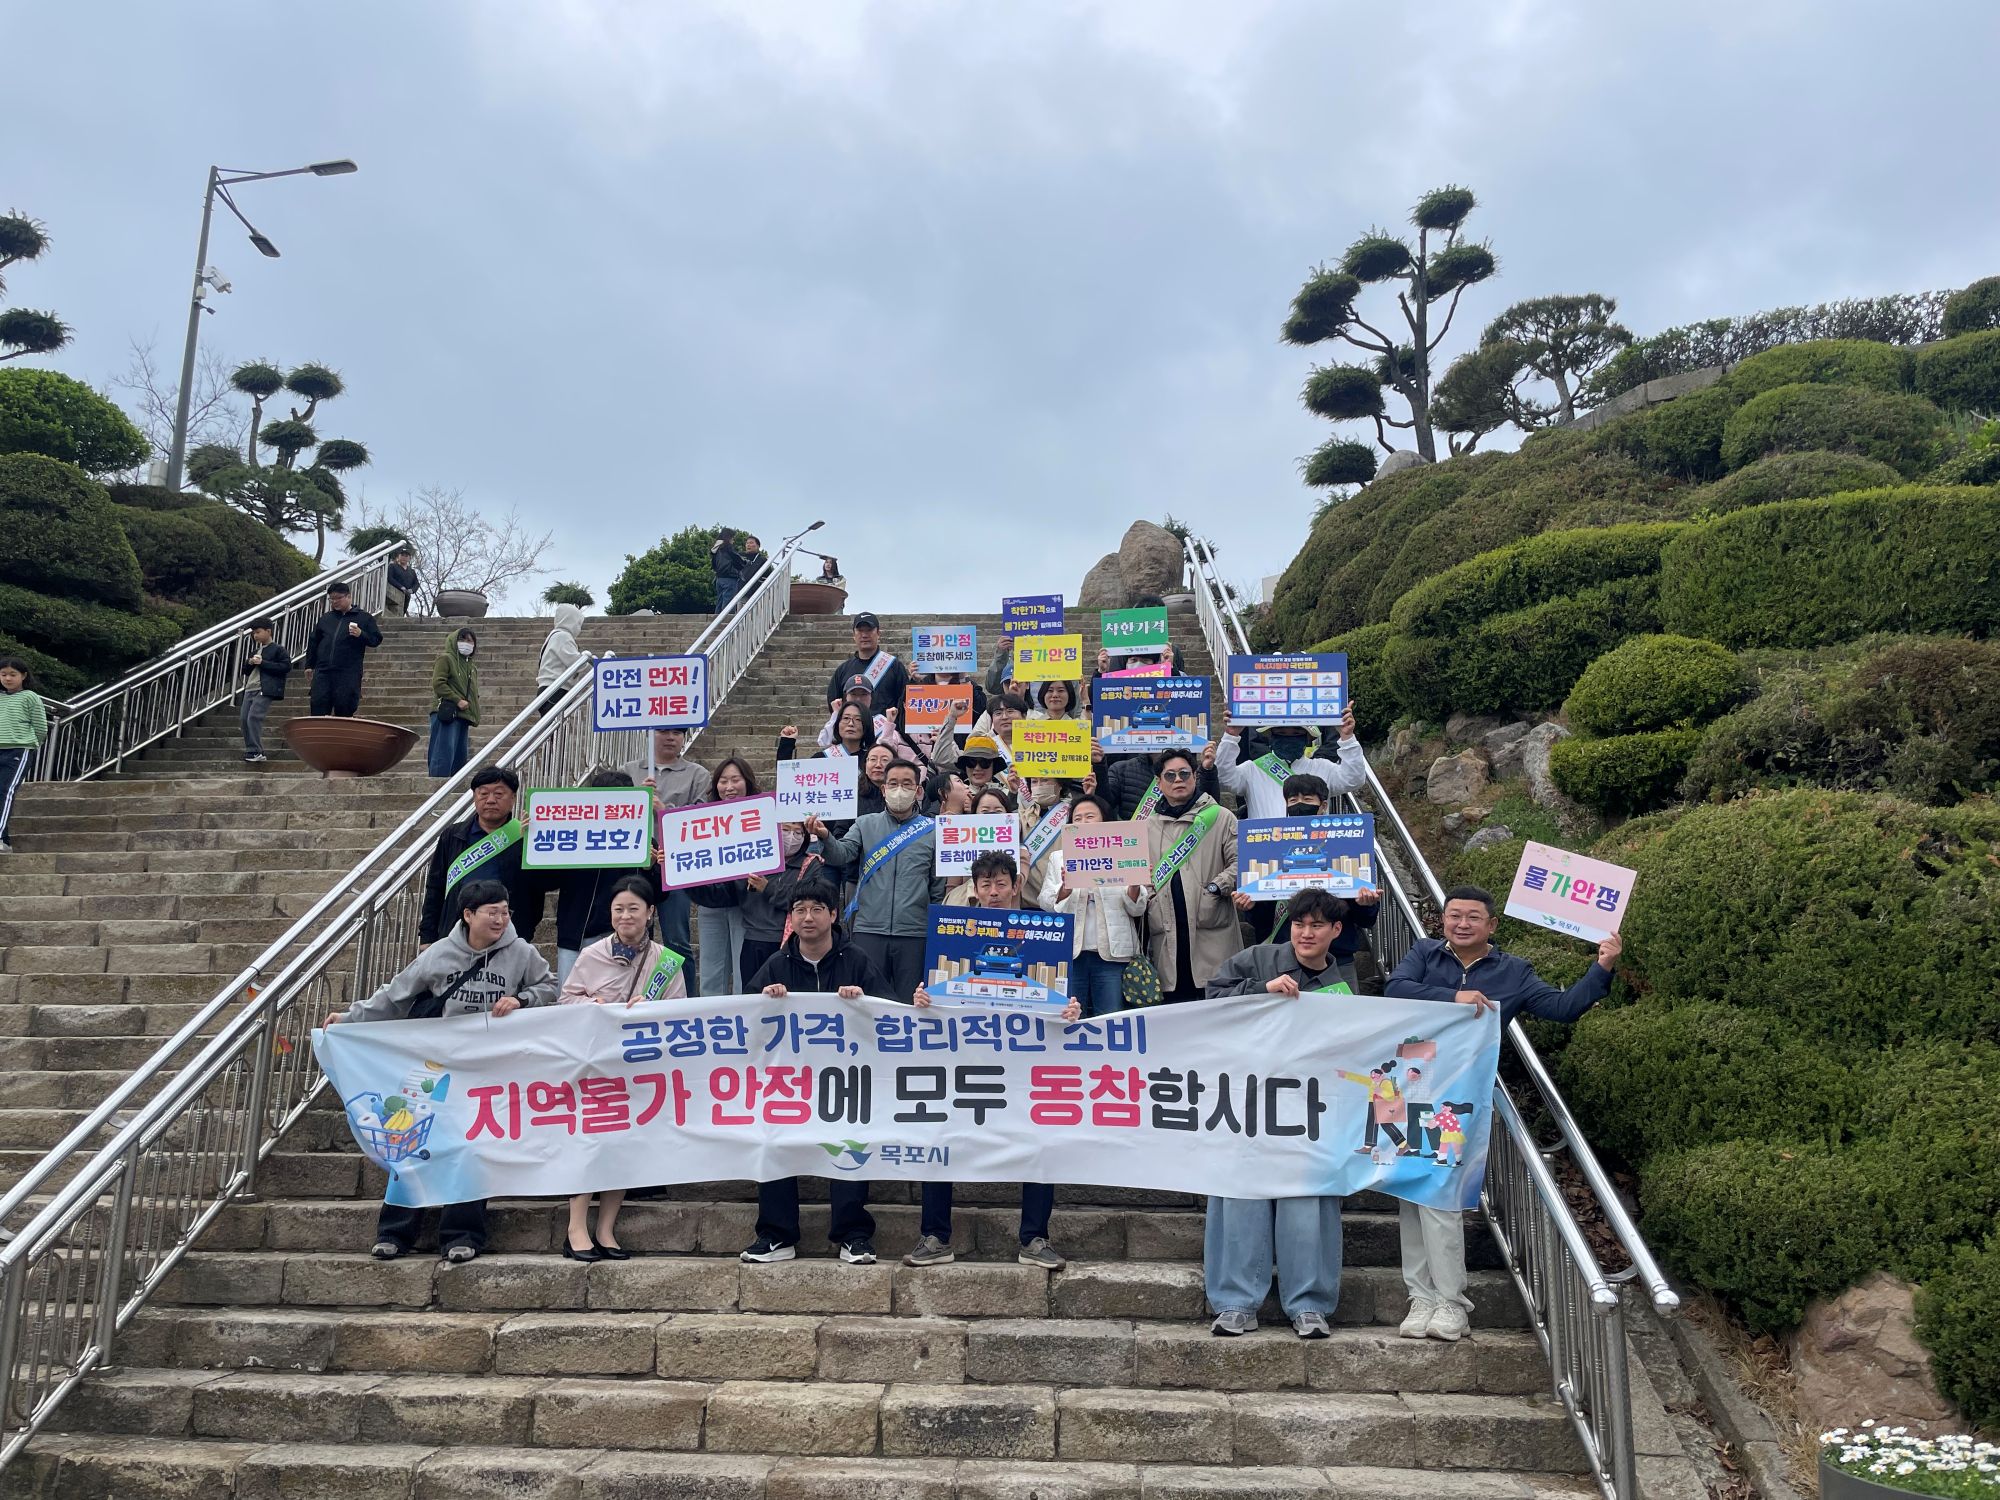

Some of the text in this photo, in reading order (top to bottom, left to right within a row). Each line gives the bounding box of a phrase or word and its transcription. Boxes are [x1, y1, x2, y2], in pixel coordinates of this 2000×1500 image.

[1004, 620, 1039, 631] 물가안정
[1104, 620, 1165, 636] 착한가격
[917, 633, 971, 648] 물가안정
[916, 651, 974, 662] 동참해주세요
[1019, 647, 1077, 663] 물가안정
[602, 665, 699, 690] 안전 먼저!
[601, 695, 700, 719] 사고 제로!
[1023, 732, 1082, 743] 착한가격으로
[1014, 751, 1058, 763] 물가안정
[794, 771, 840, 787] 착한가격
[779, 788, 855, 805] 다시 찾는 목포
[535, 804, 644, 821] 안전관리 철저!
[680, 808, 762, 843] 큰 사고!
[534, 828, 643, 852] 생명 보호!
[942, 825, 1013, 845] 물가안정
[1074, 835, 1138, 849] 착한가격으로
[1310, 829, 1365, 840] 동참해주세요!
[460, 840, 497, 872] 에너지
[718, 838, 774, 866] 잠깐의
[1167, 832, 1199, 867] 에너지
[1065, 857, 1113, 872] 물가안정
[1523, 865, 1621, 913] 물가안정
[936, 924, 965, 936] 승용차
[1006, 928, 1066, 942] 동참해주세요!
[1558, 919, 1581, 934] 목포시
[621, 1012, 1148, 1064] 공정한 가격, 합리적인 소비
[464, 1063, 1328, 1143] 지역물가 안정에 모두 동참합시다
[878, 1143, 950, 1168] 목포시
